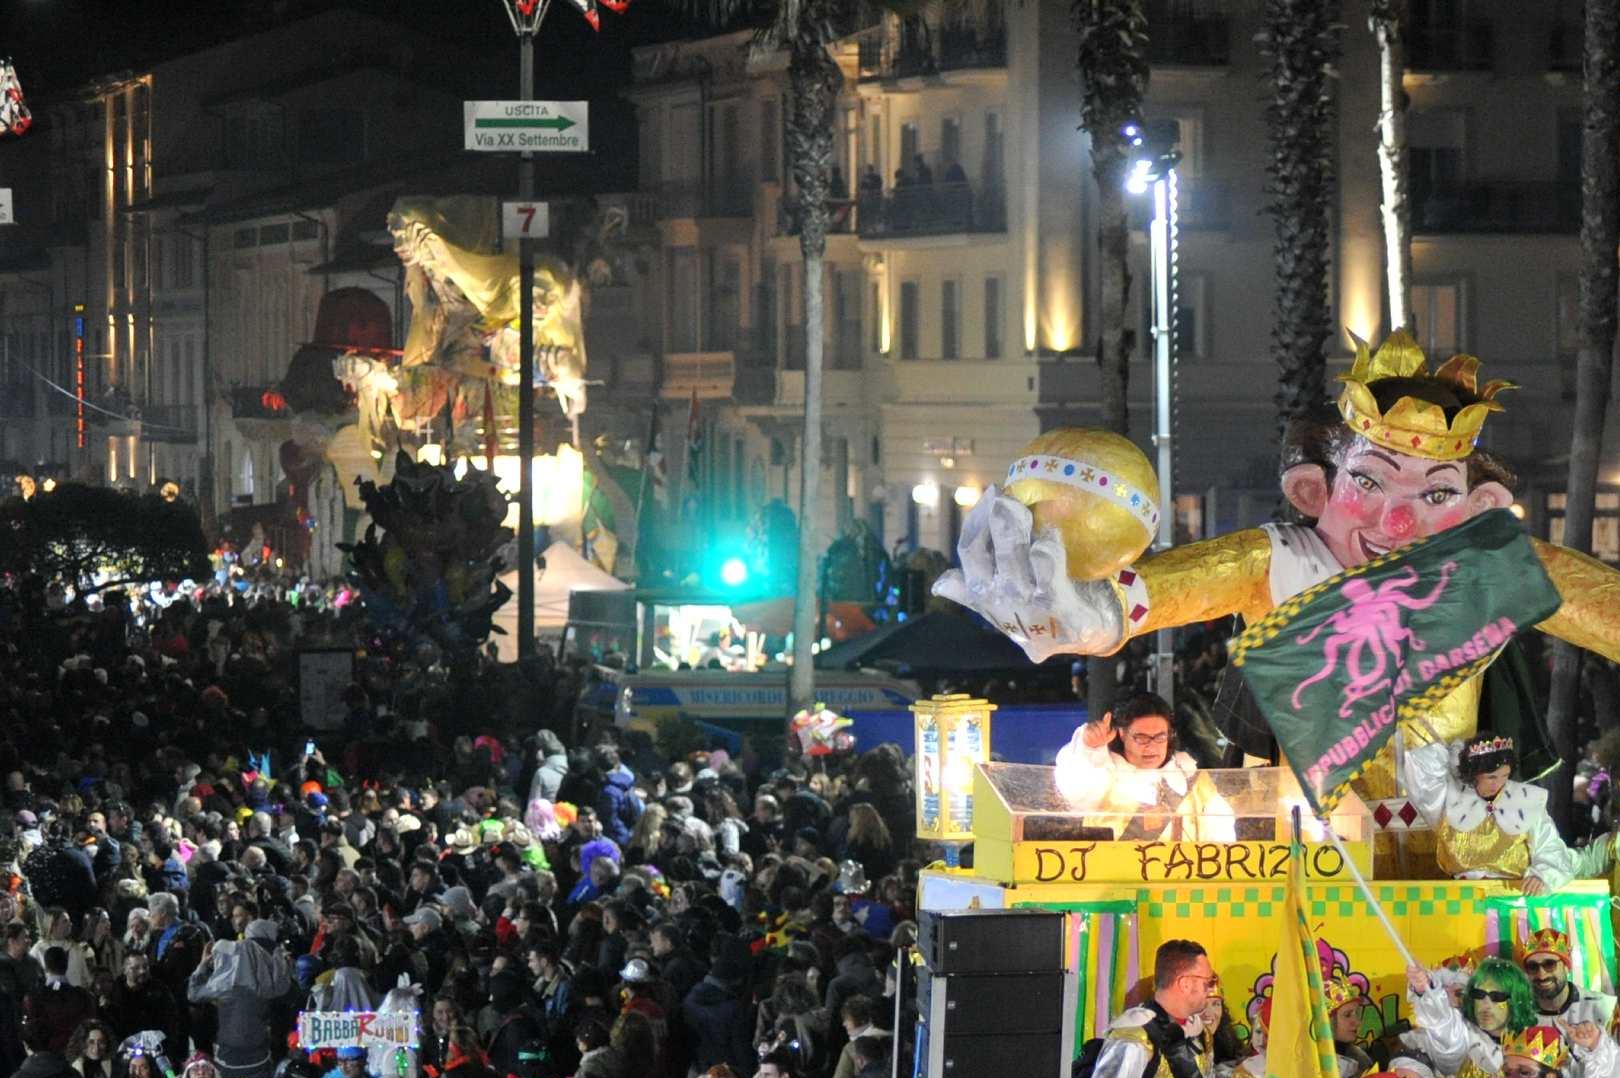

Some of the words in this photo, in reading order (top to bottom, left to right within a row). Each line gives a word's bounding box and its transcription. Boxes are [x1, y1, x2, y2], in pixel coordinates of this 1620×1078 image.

[505, 105, 549, 117] USCITA
[475, 133, 494, 146] Via
[498, 133, 515, 146] XX
[519, 132, 579, 146] Settembre
[517, 207, 536, 233] 7
[1418, 616, 1518, 682] DARSENA
[1035, 842, 1096, 882] DJ
[1135, 841, 1346, 882] FABRIZIO
